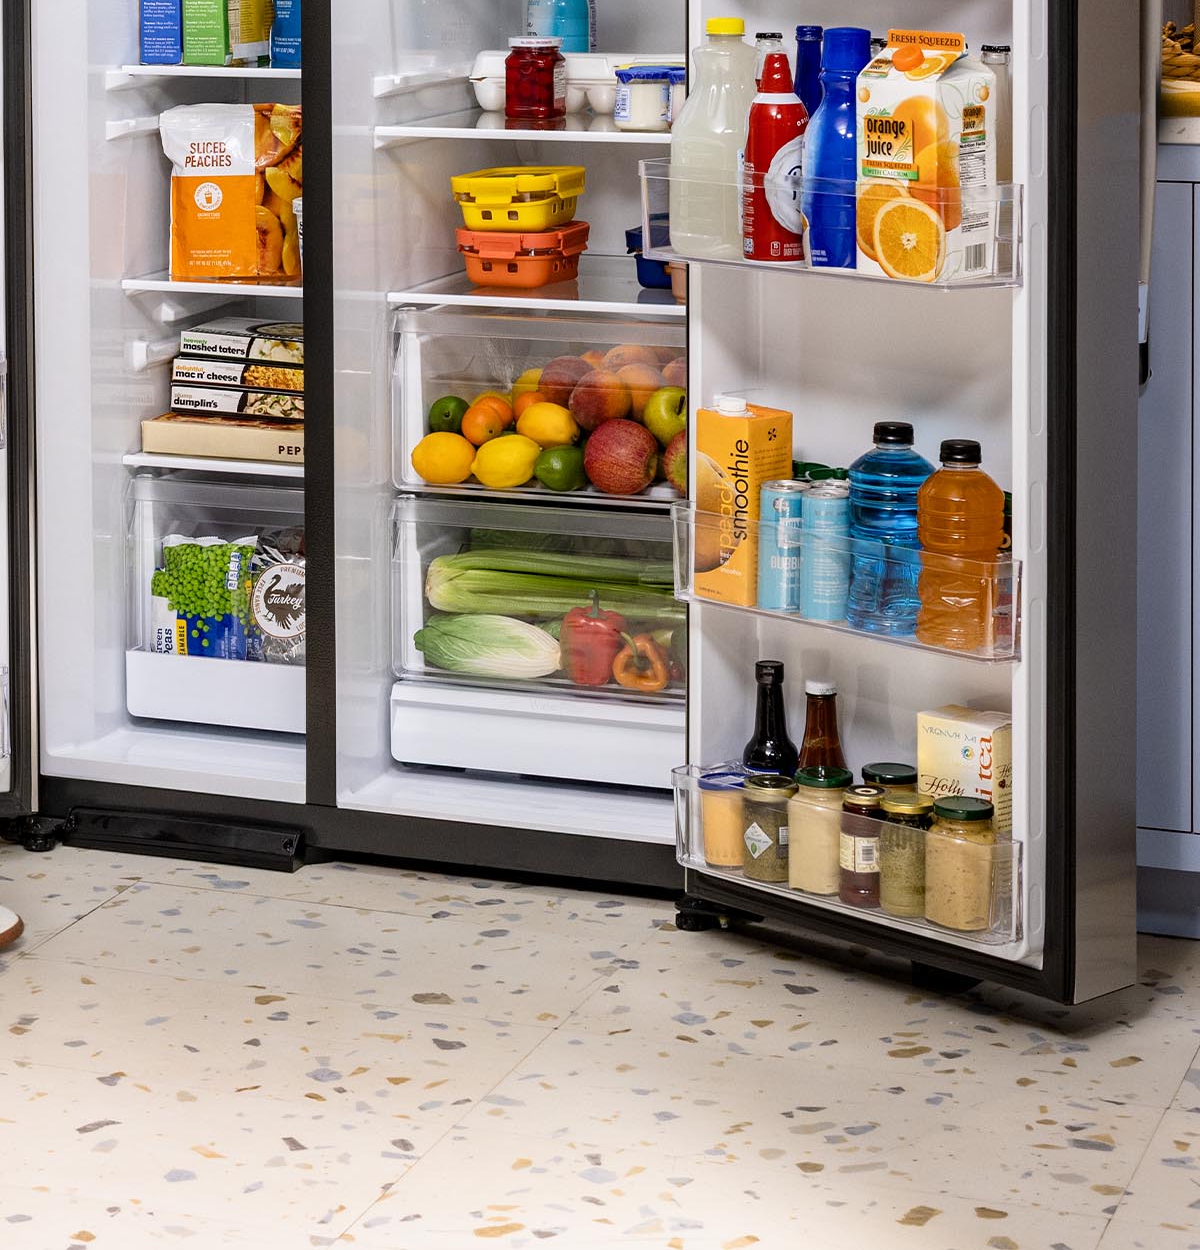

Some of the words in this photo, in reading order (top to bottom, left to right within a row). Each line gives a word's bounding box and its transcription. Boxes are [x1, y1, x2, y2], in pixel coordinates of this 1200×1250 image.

[890, 33, 916, 44] FRESH
[918, 35, 961, 47] SQUEEZED
[963, 106, 982, 118] orange
[866, 118, 905, 138] orange
[962, 118, 976, 131] juice
[190, 142, 226, 154] SLICED
[866, 135, 893, 158] juice
[184, 154, 232, 168] PEACHES
[183, 343, 218, 352] mashed
[218, 346, 246, 356] taters
[176, 370, 196, 378] mac
[206, 372, 238, 382] cheese
[174, 397, 218, 408] dumplin's
[728, 439, 749, 541] smoothie
[268, 594, 303, 610] Turkey
[920, 774, 965, 796] Holly
